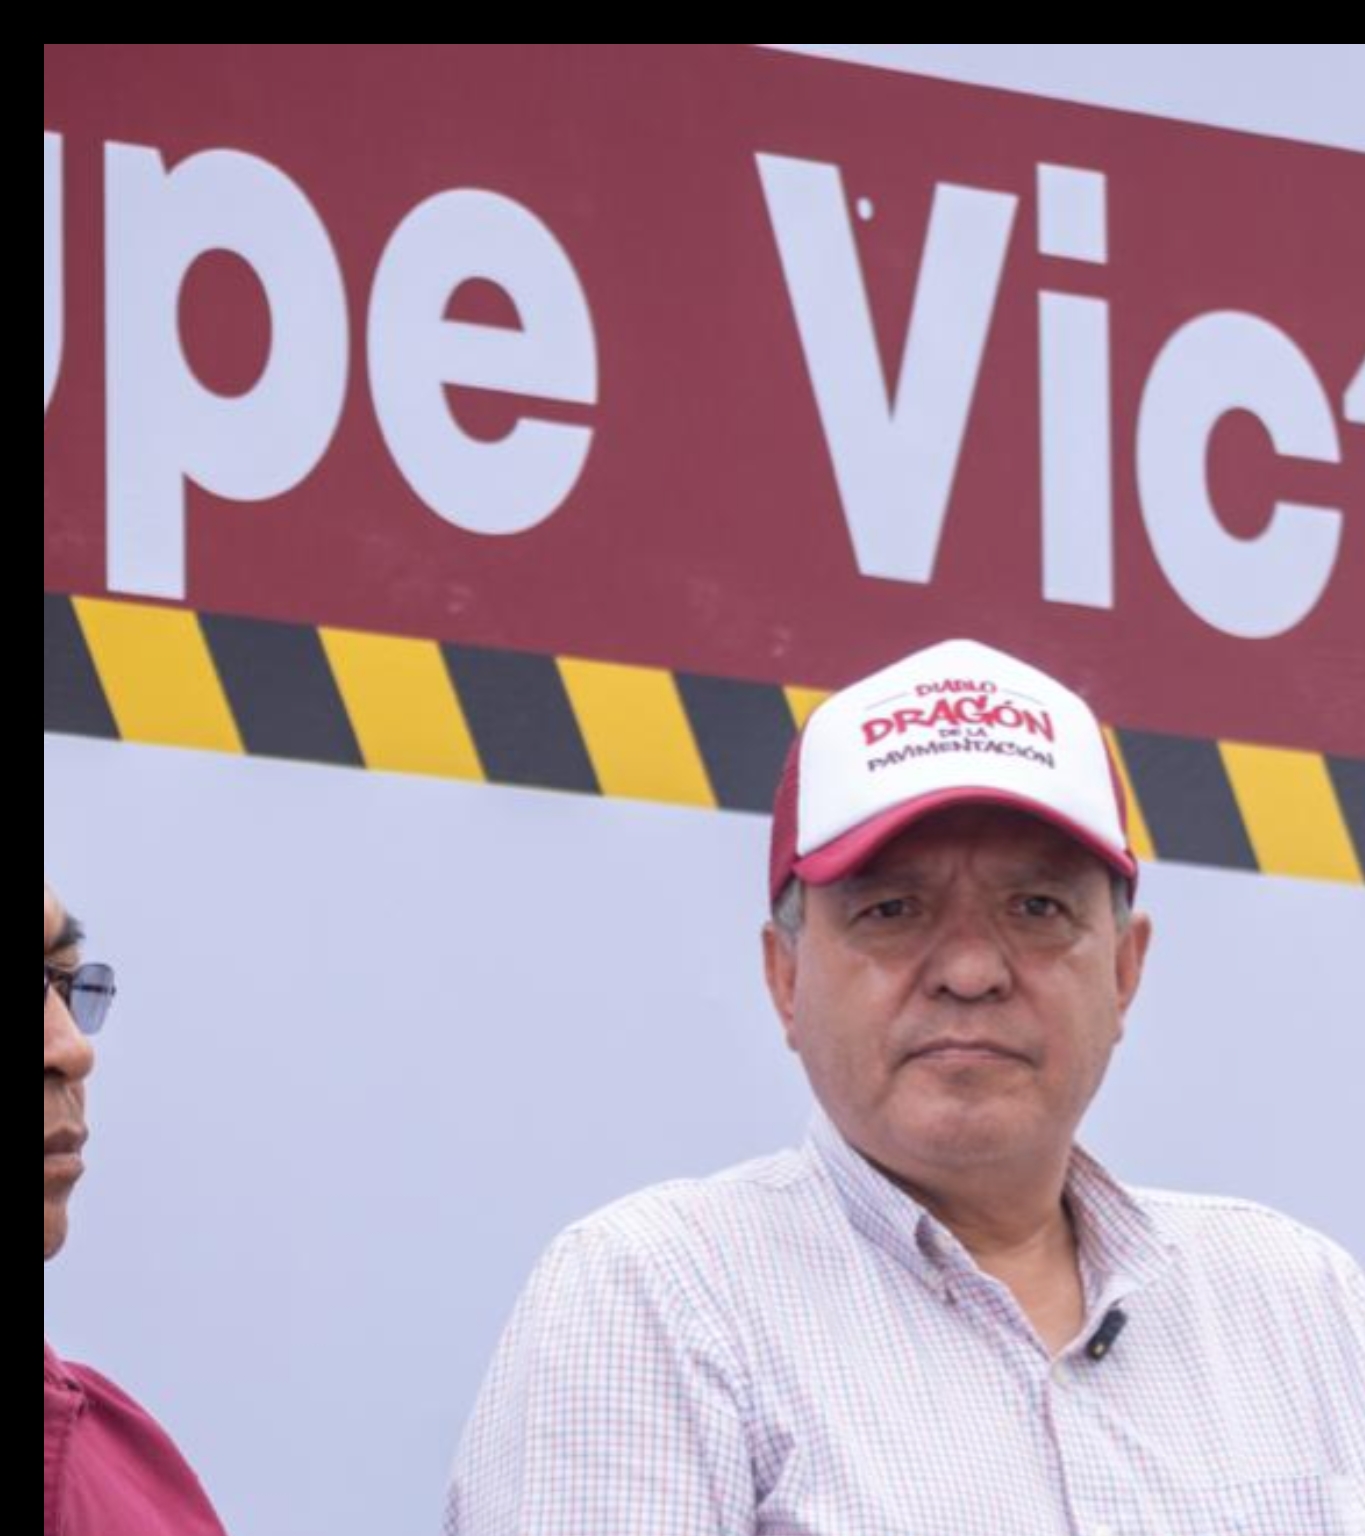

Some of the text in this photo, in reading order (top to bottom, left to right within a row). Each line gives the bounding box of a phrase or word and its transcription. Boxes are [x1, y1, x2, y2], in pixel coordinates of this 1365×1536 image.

[44, 130, 600, 602] pe
[915, 679, 997, 697] DIABLO
[861, 694, 1055, 746] DRAGÓN
[938, 727, 987, 738] DE LA
[867, 738, 1055, 772] PAVIMENTACIÓN
